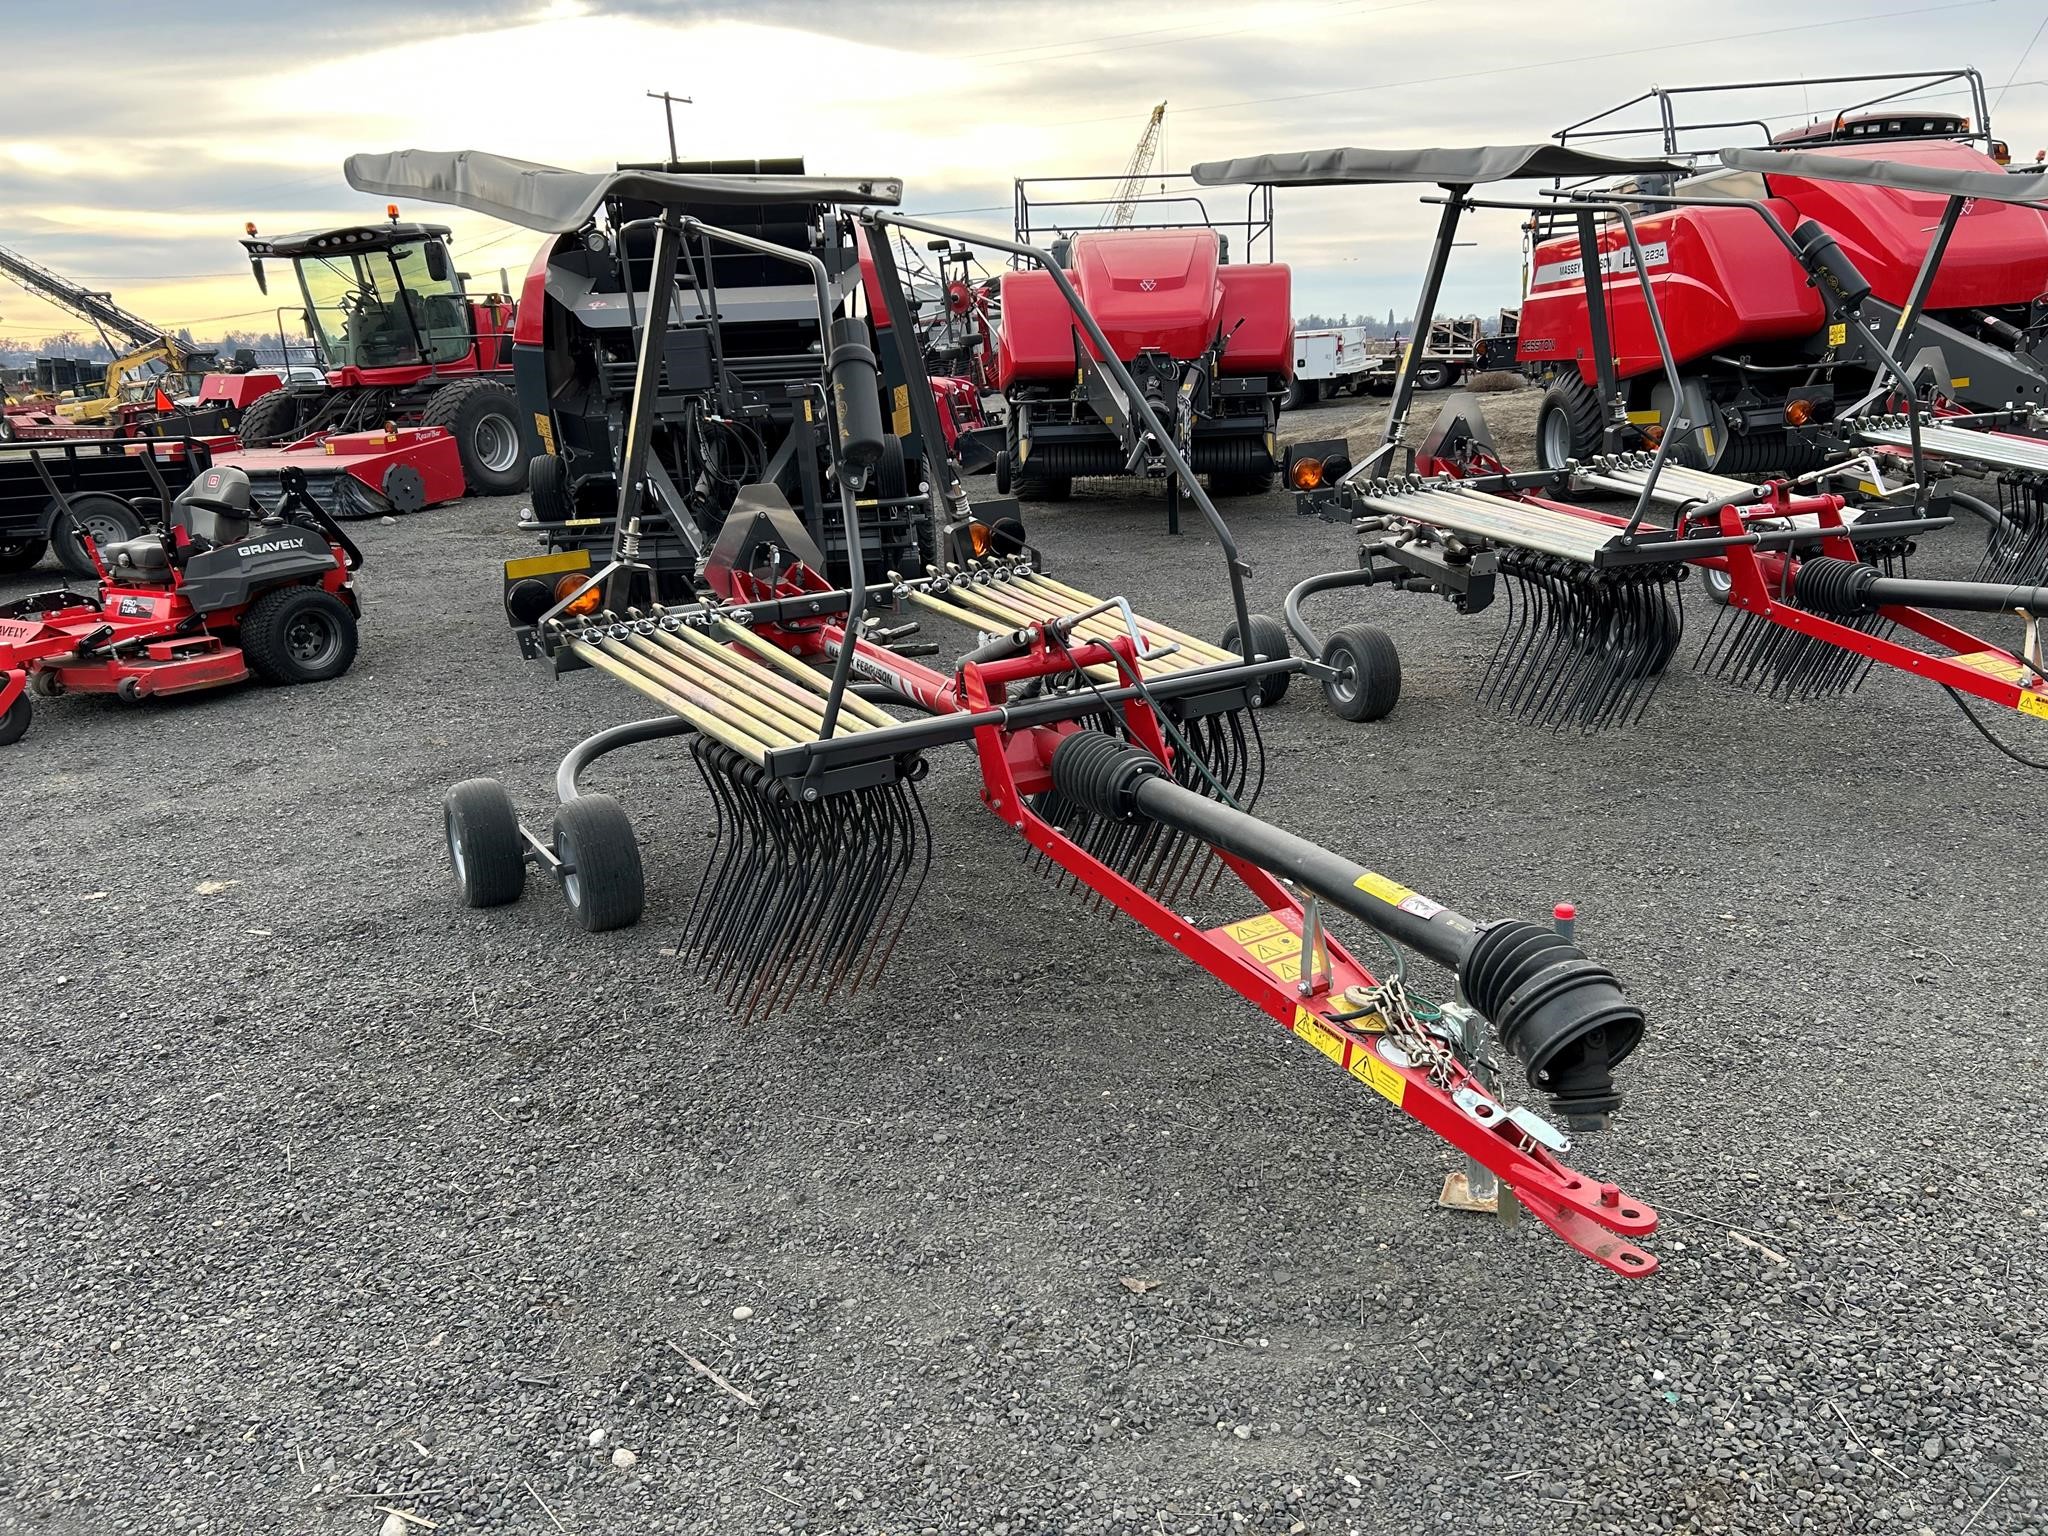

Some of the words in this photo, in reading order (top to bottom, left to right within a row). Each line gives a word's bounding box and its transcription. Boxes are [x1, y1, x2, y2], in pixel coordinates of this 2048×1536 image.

[1645, 248, 1664, 261] 2234
[1559, 263, 1581, 276] MASSEY
[1521, 339, 1555, 351] HESSTON
[237, 538, 304, 557] GRAVELY
[122, 599, 137, 607] PRO
[121, 606, 138, 614] TURN
[0, 625, 28, 638] VELY
[857, 658, 894, 686] FERGUSON
